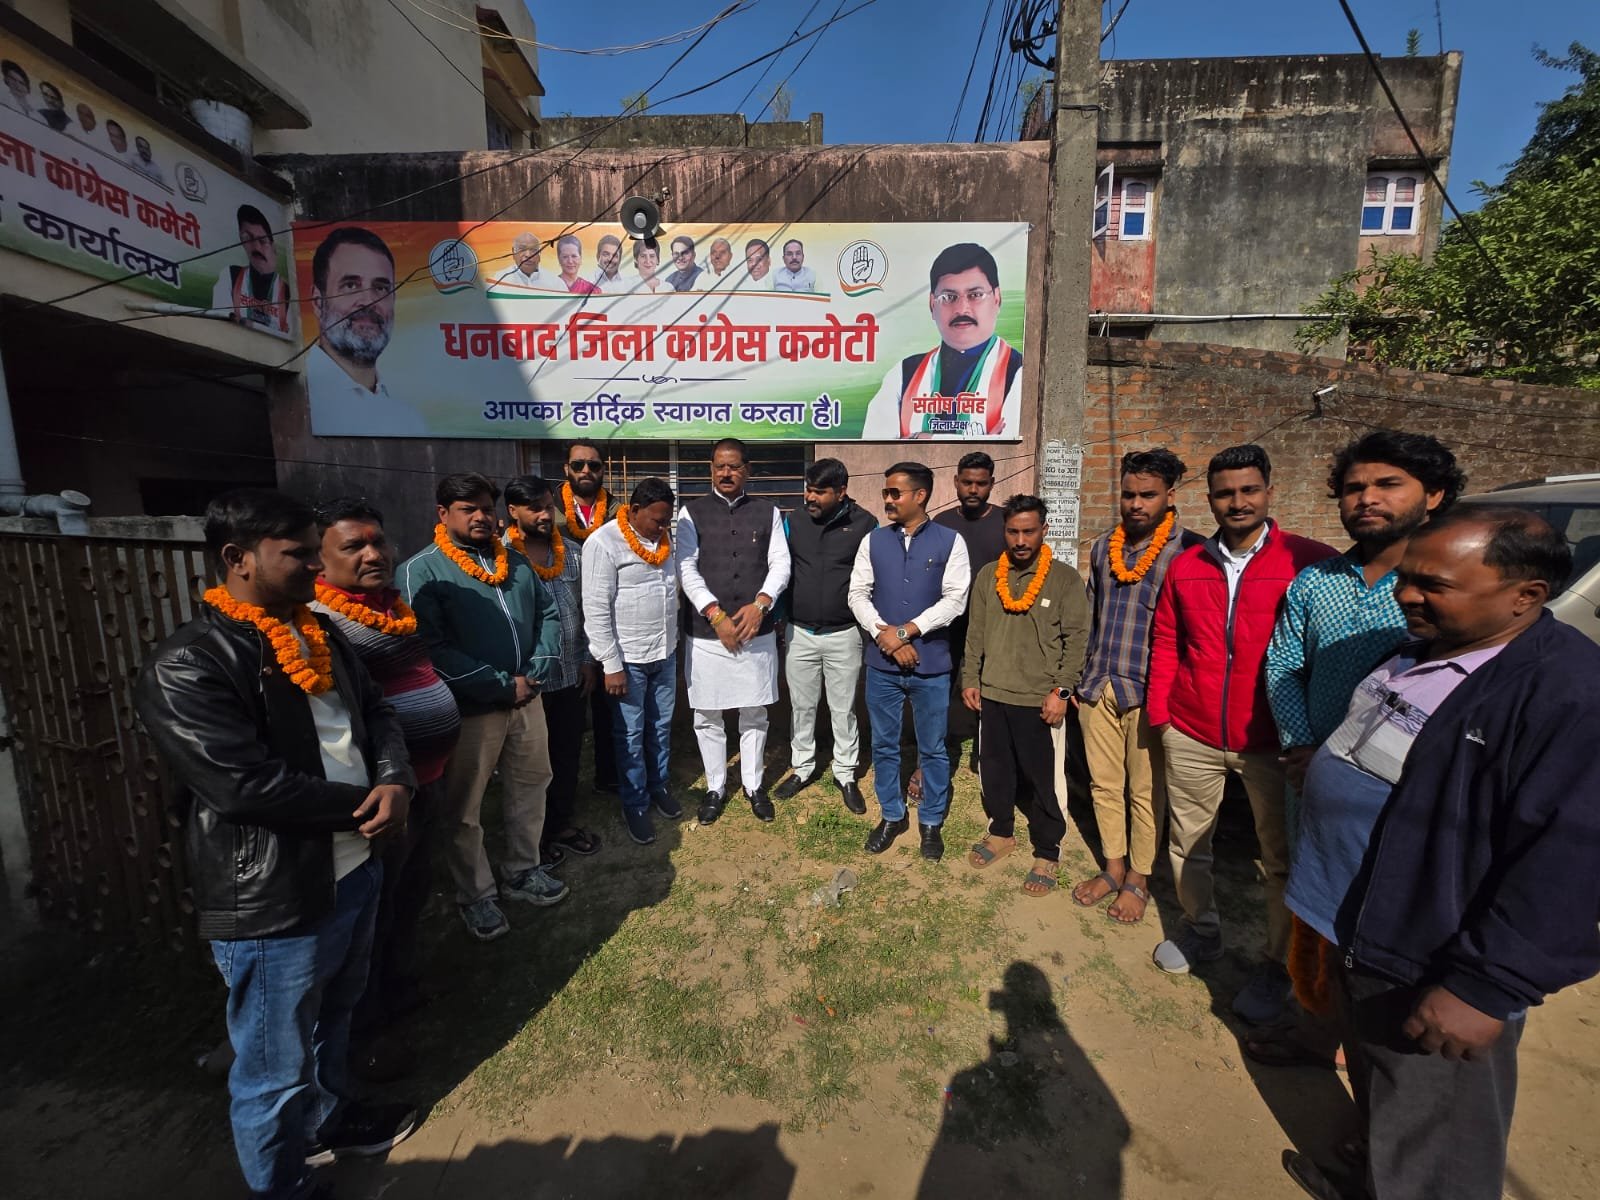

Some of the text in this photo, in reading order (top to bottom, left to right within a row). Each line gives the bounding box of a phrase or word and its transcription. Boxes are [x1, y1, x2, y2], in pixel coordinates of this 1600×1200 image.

[0, 132, 36, 178] ला
[40, 151, 129, 219] कांग्रेस
[132, 195, 201, 249] कमेटी
[18, 201, 181, 286] कार्यालय
[440, 312, 879, 362] धनबाद जिला कांग्रेस कमेटी
[483, 394, 840, 427] आपका हार्दिक स्वागत करता है।
[912, 391, 986, 414] संतोष सिंह
